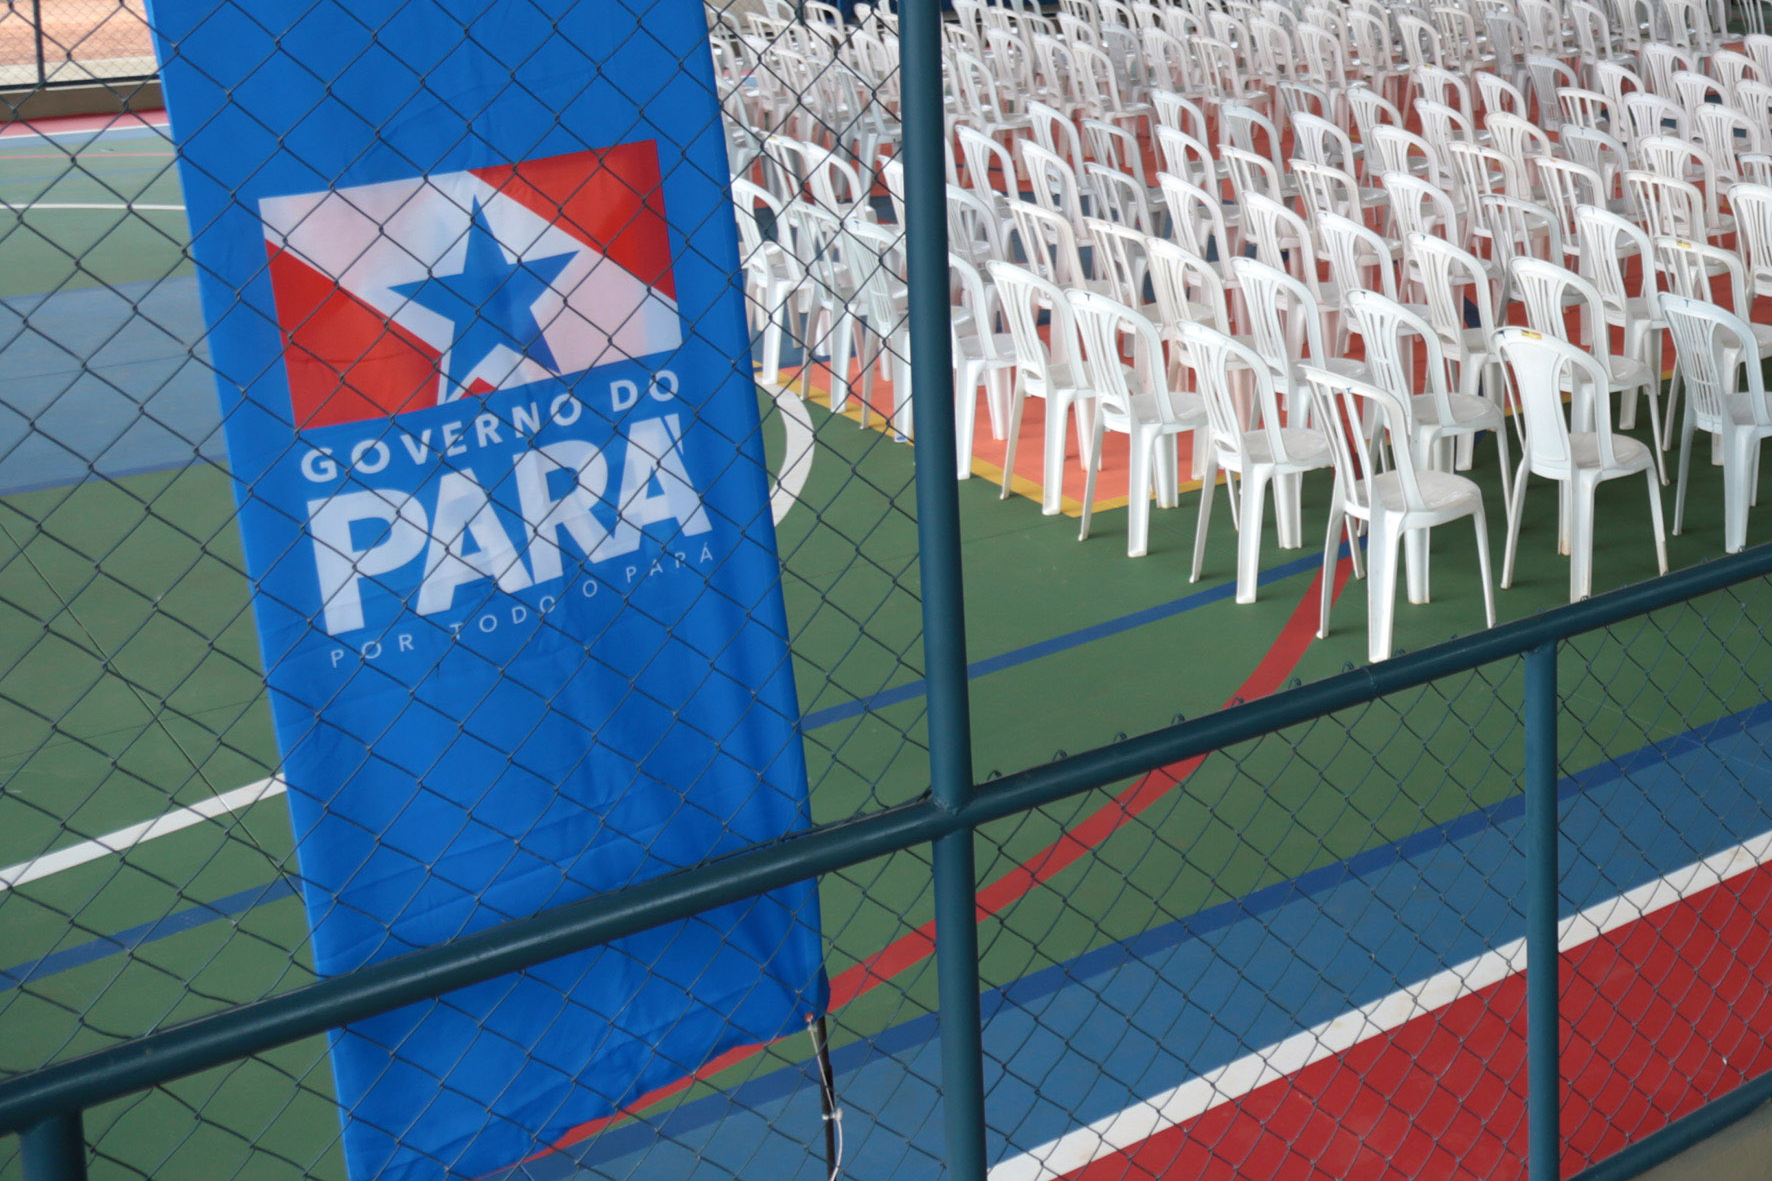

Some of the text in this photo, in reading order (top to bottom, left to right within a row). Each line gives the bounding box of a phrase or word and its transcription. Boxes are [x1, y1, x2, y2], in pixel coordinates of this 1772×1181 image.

[300, 369, 680, 483] GOVERNO DO
[330, 541, 714, 669] POR TODO O PARÁ
